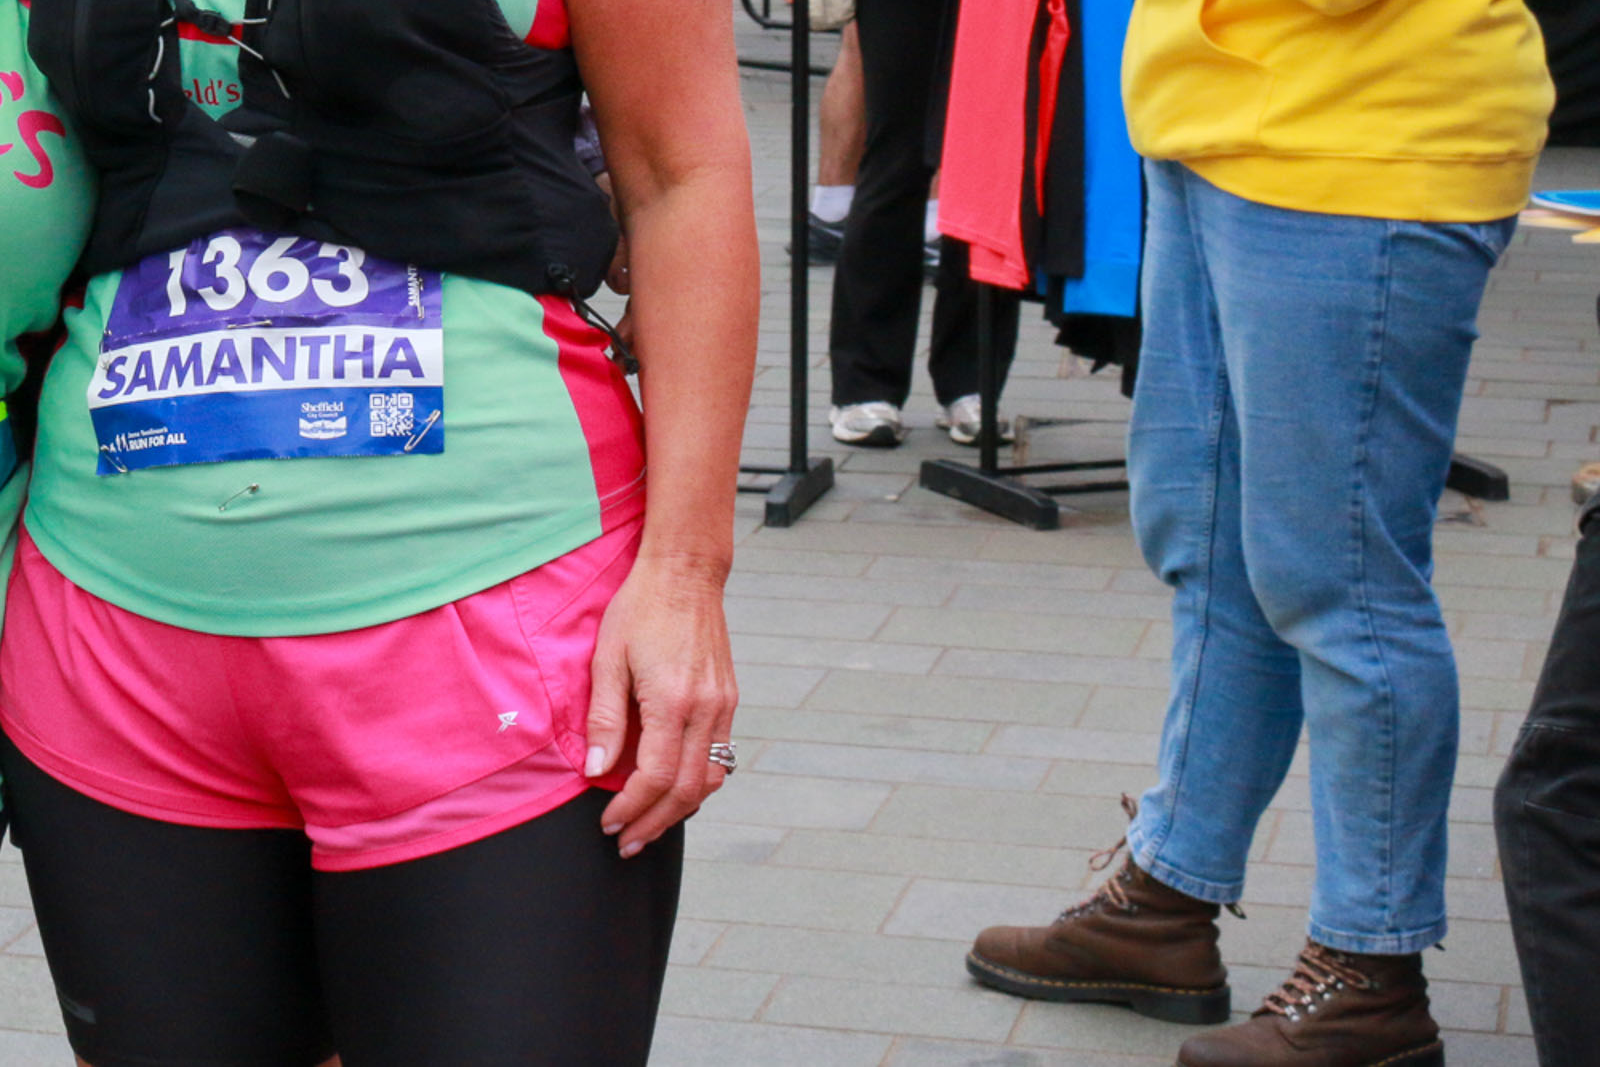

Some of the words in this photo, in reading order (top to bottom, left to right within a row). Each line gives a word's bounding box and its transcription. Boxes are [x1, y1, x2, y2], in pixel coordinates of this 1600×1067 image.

[167, 236, 369, 317] 1363
[98, 334, 425, 398] SAMANTHA
[301, 401, 344, 413] Sheffield
[166, 432, 187, 445] ALL
